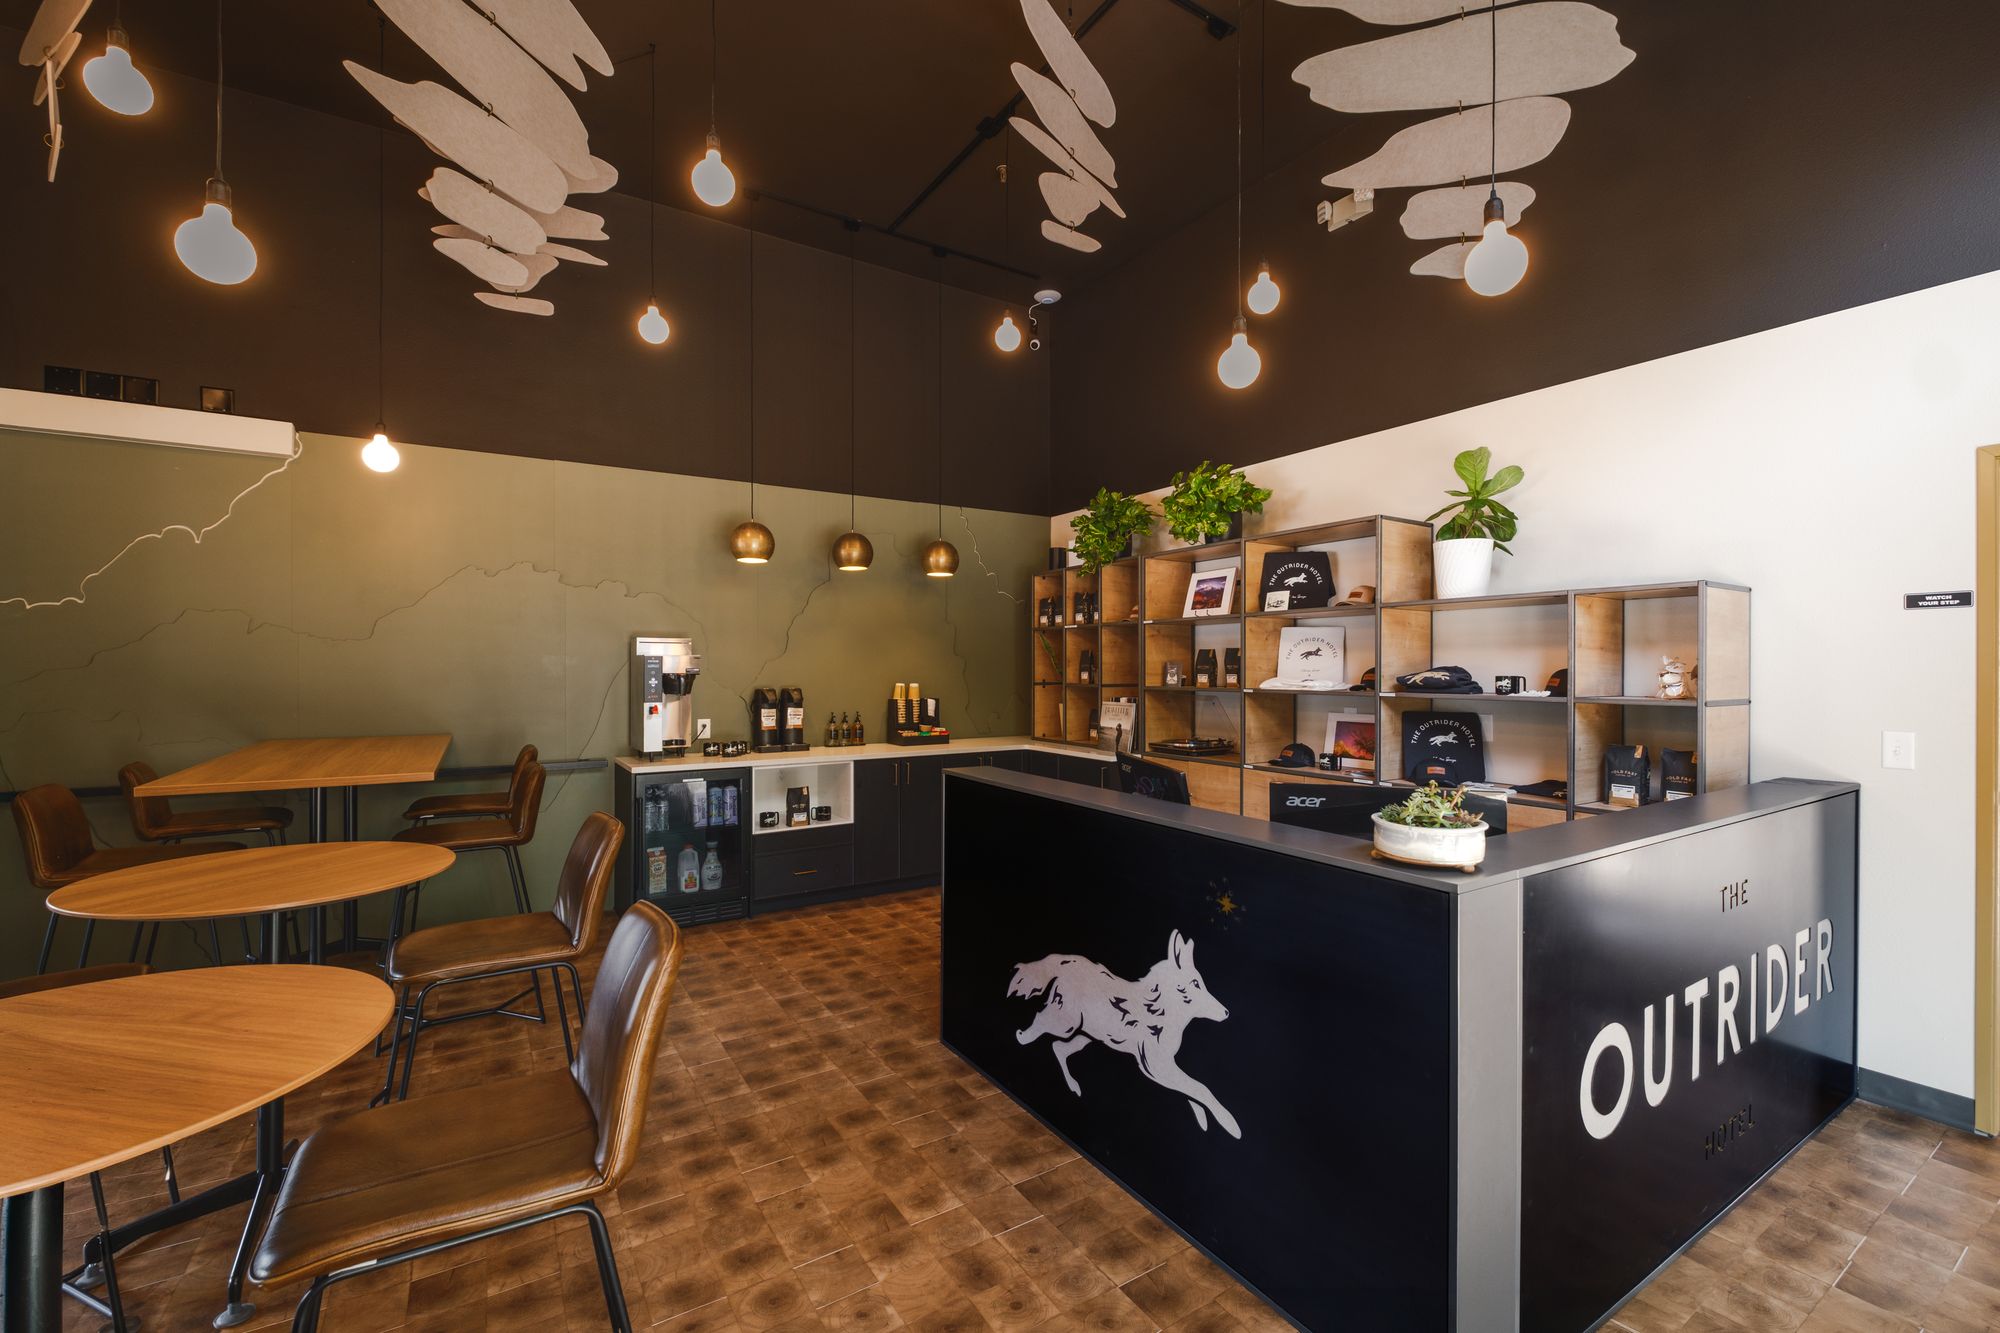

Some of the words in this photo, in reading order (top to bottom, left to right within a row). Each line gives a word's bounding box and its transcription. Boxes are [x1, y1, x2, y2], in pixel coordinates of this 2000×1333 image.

[1269, 574, 1278, 586] THE
[1277, 562, 1309, 575] OUTRIDER
[1309, 566, 1323, 585] HOTEL
[1286, 649, 1294, 660] THE
[1293, 637, 1325, 649] OUTRIDER
[1326, 641, 1339, 659] HOTEL
[1411, 729, 1421, 744] THE
[1420, 719, 1460, 731] OUTRIDER
[1461, 725, 1476, 748] HOTEL
[1286, 796, 1326, 808] acer
[1720, 879, 1748, 913] THE
[1580, 918, 1833, 1140] OUTRIDER
[1705, 1104, 1756, 1160] HOTEL
